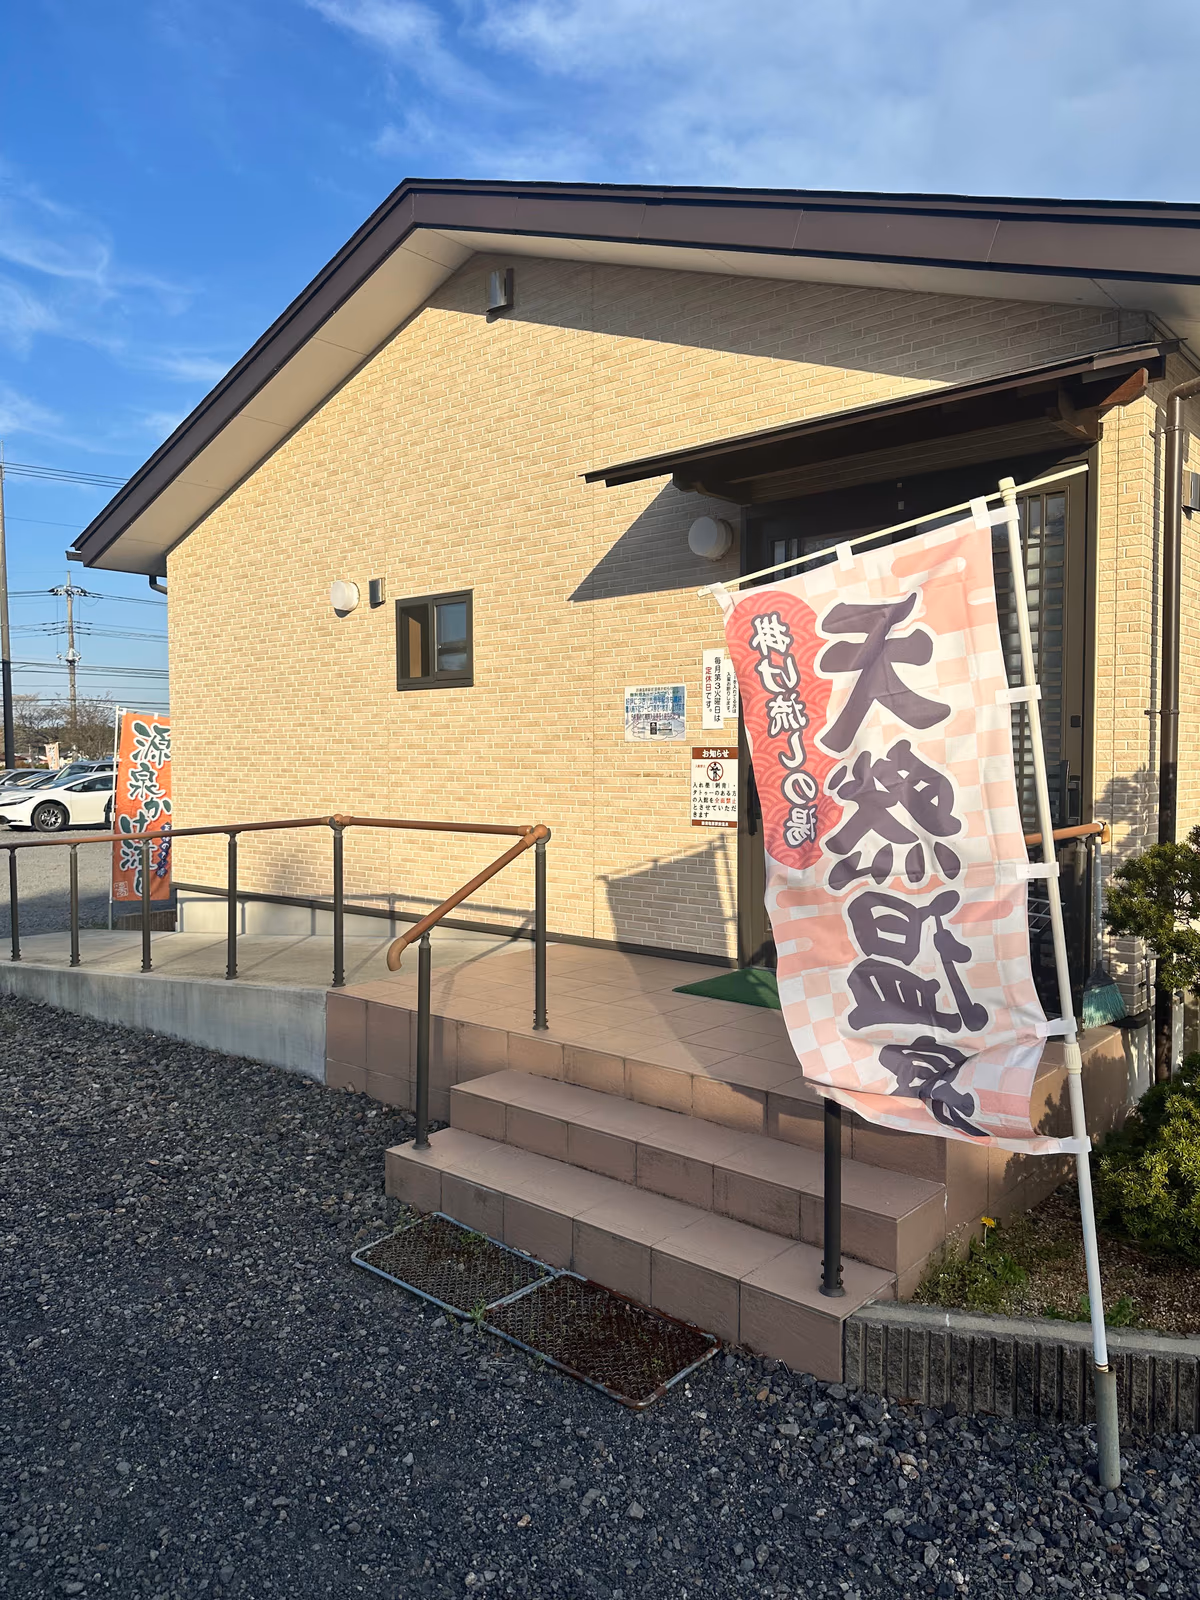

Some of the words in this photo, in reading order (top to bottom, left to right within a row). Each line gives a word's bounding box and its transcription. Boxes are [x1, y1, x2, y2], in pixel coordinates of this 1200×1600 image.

[702, 749, 729, 758] お知らせ
[693, 804, 736, 812] とさせていただ
